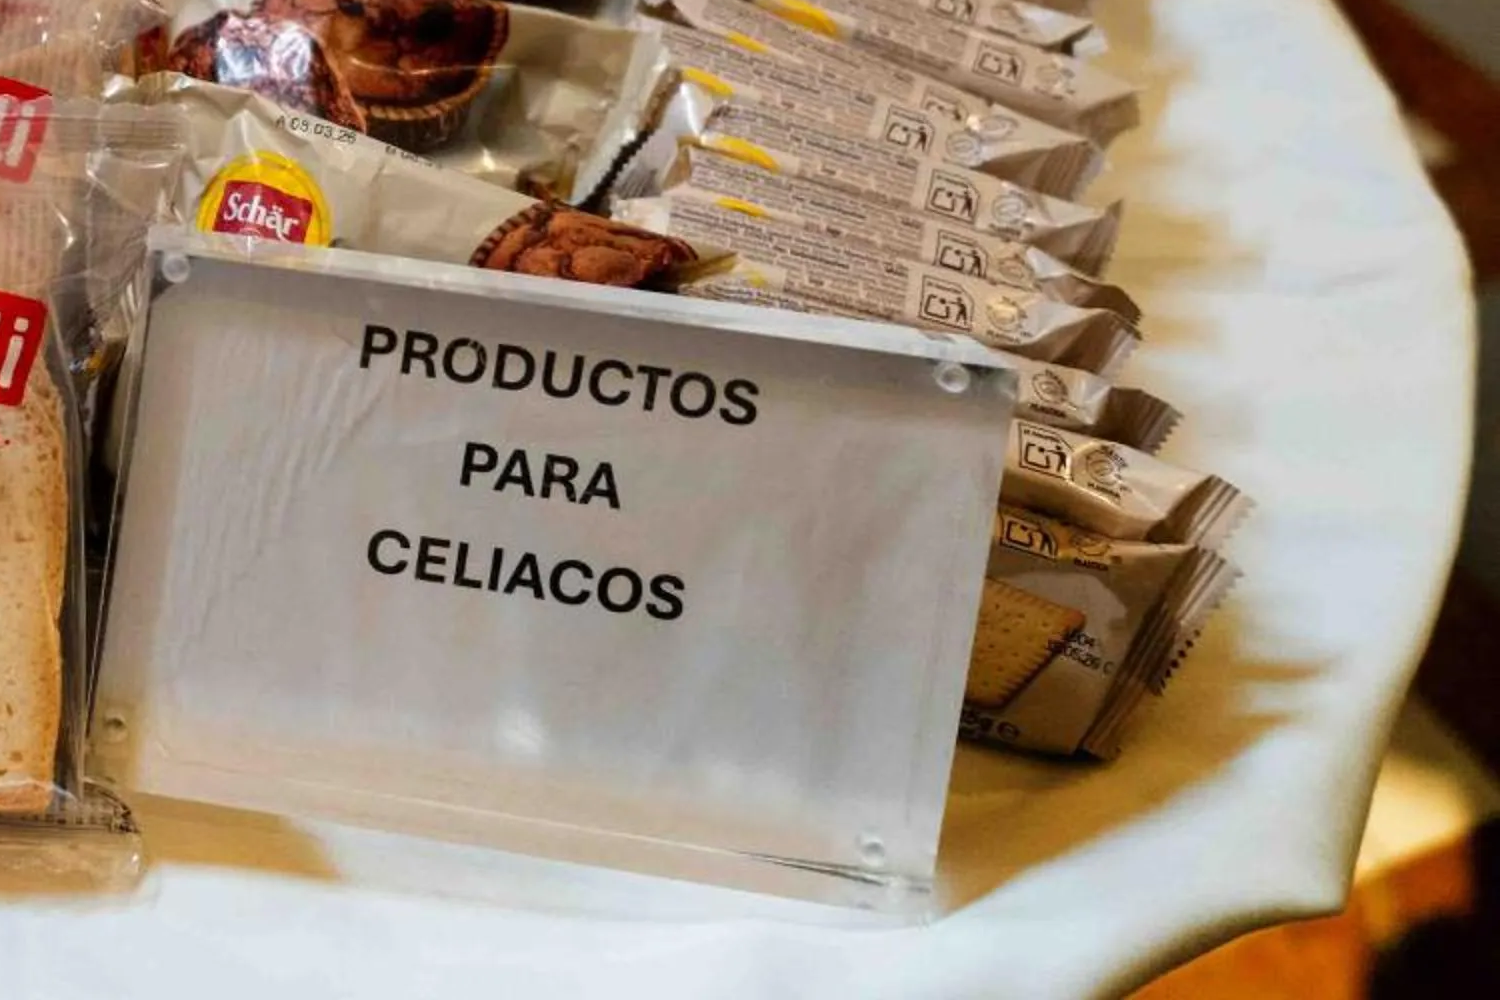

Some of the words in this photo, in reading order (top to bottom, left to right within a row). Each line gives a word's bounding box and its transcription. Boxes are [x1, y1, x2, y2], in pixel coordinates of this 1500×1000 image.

[223, 191, 300, 242] Schär
[359, 324, 760, 426] PRODUCTOS
[460, 442, 621, 509] PARA
[367, 529, 686, 621] CELIACOS
